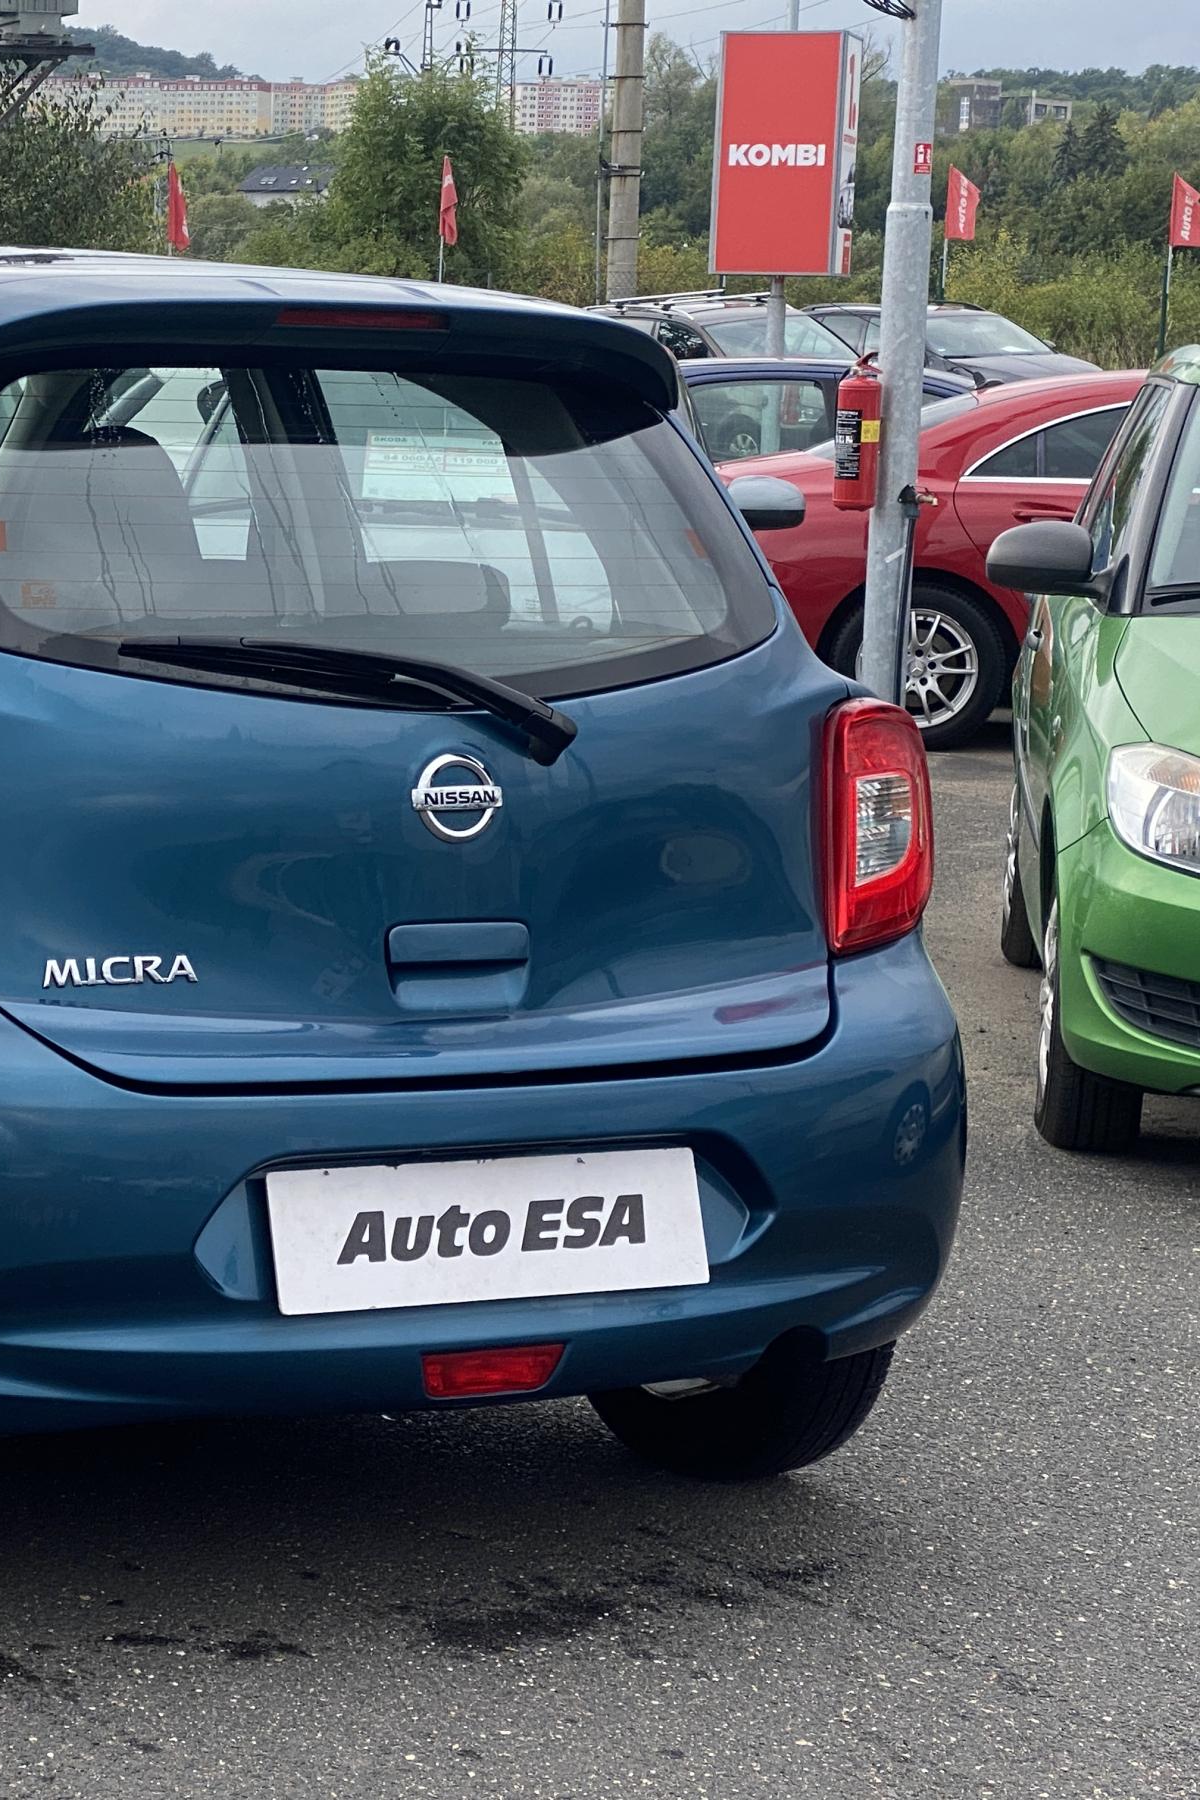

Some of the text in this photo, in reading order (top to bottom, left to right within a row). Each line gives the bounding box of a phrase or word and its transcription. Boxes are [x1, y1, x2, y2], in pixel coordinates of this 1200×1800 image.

[728, 143, 826, 167] KOMBI
[1181, 205, 1193, 241] Auto
[423, 790, 496, 806] NISSAN
[42, 954, 198, 989] MICRA
[336, 1193, 647, 1266] Auto ESA
